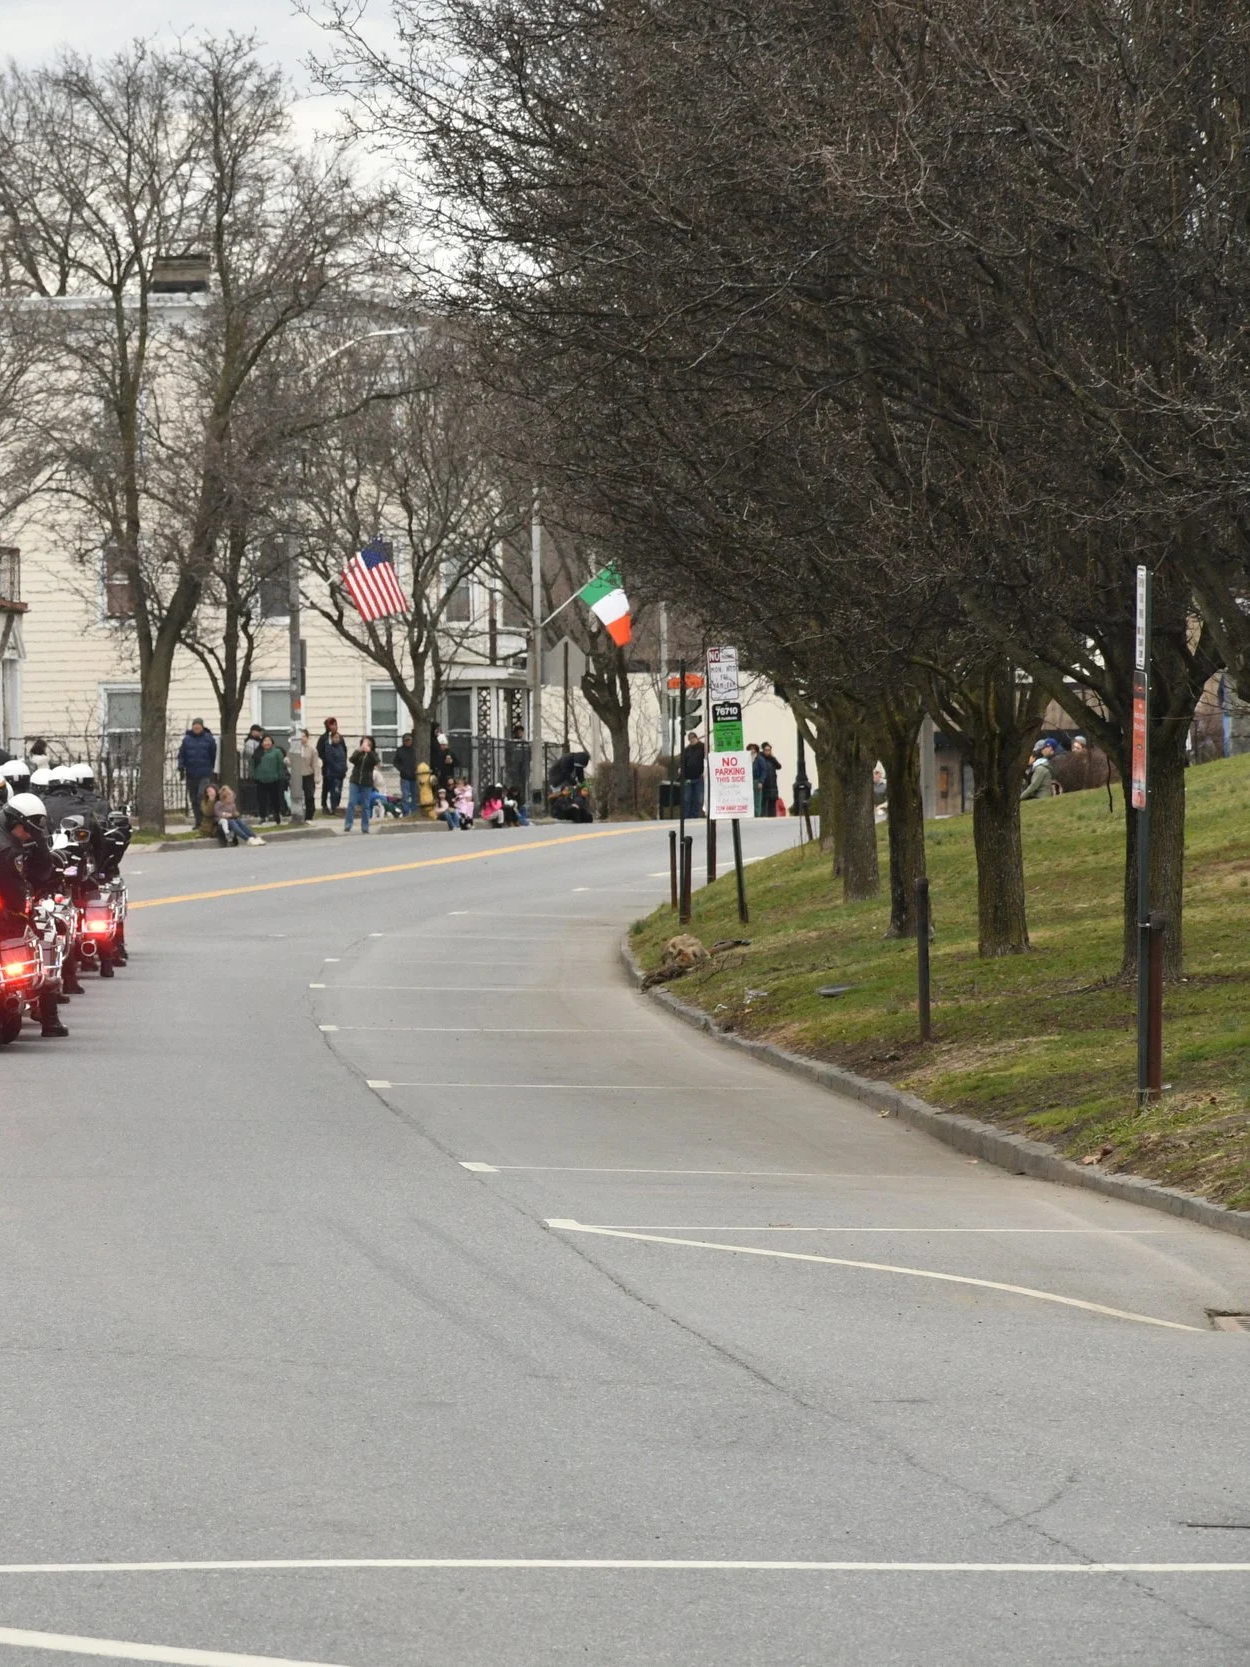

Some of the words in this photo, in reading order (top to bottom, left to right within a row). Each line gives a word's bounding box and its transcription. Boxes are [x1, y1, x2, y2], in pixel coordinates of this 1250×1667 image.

[709, 650, 720, 662] NO
[715, 707, 739, 716] 76710
[722, 757, 738, 767] NO
[715, 767, 746, 776] PARKING
